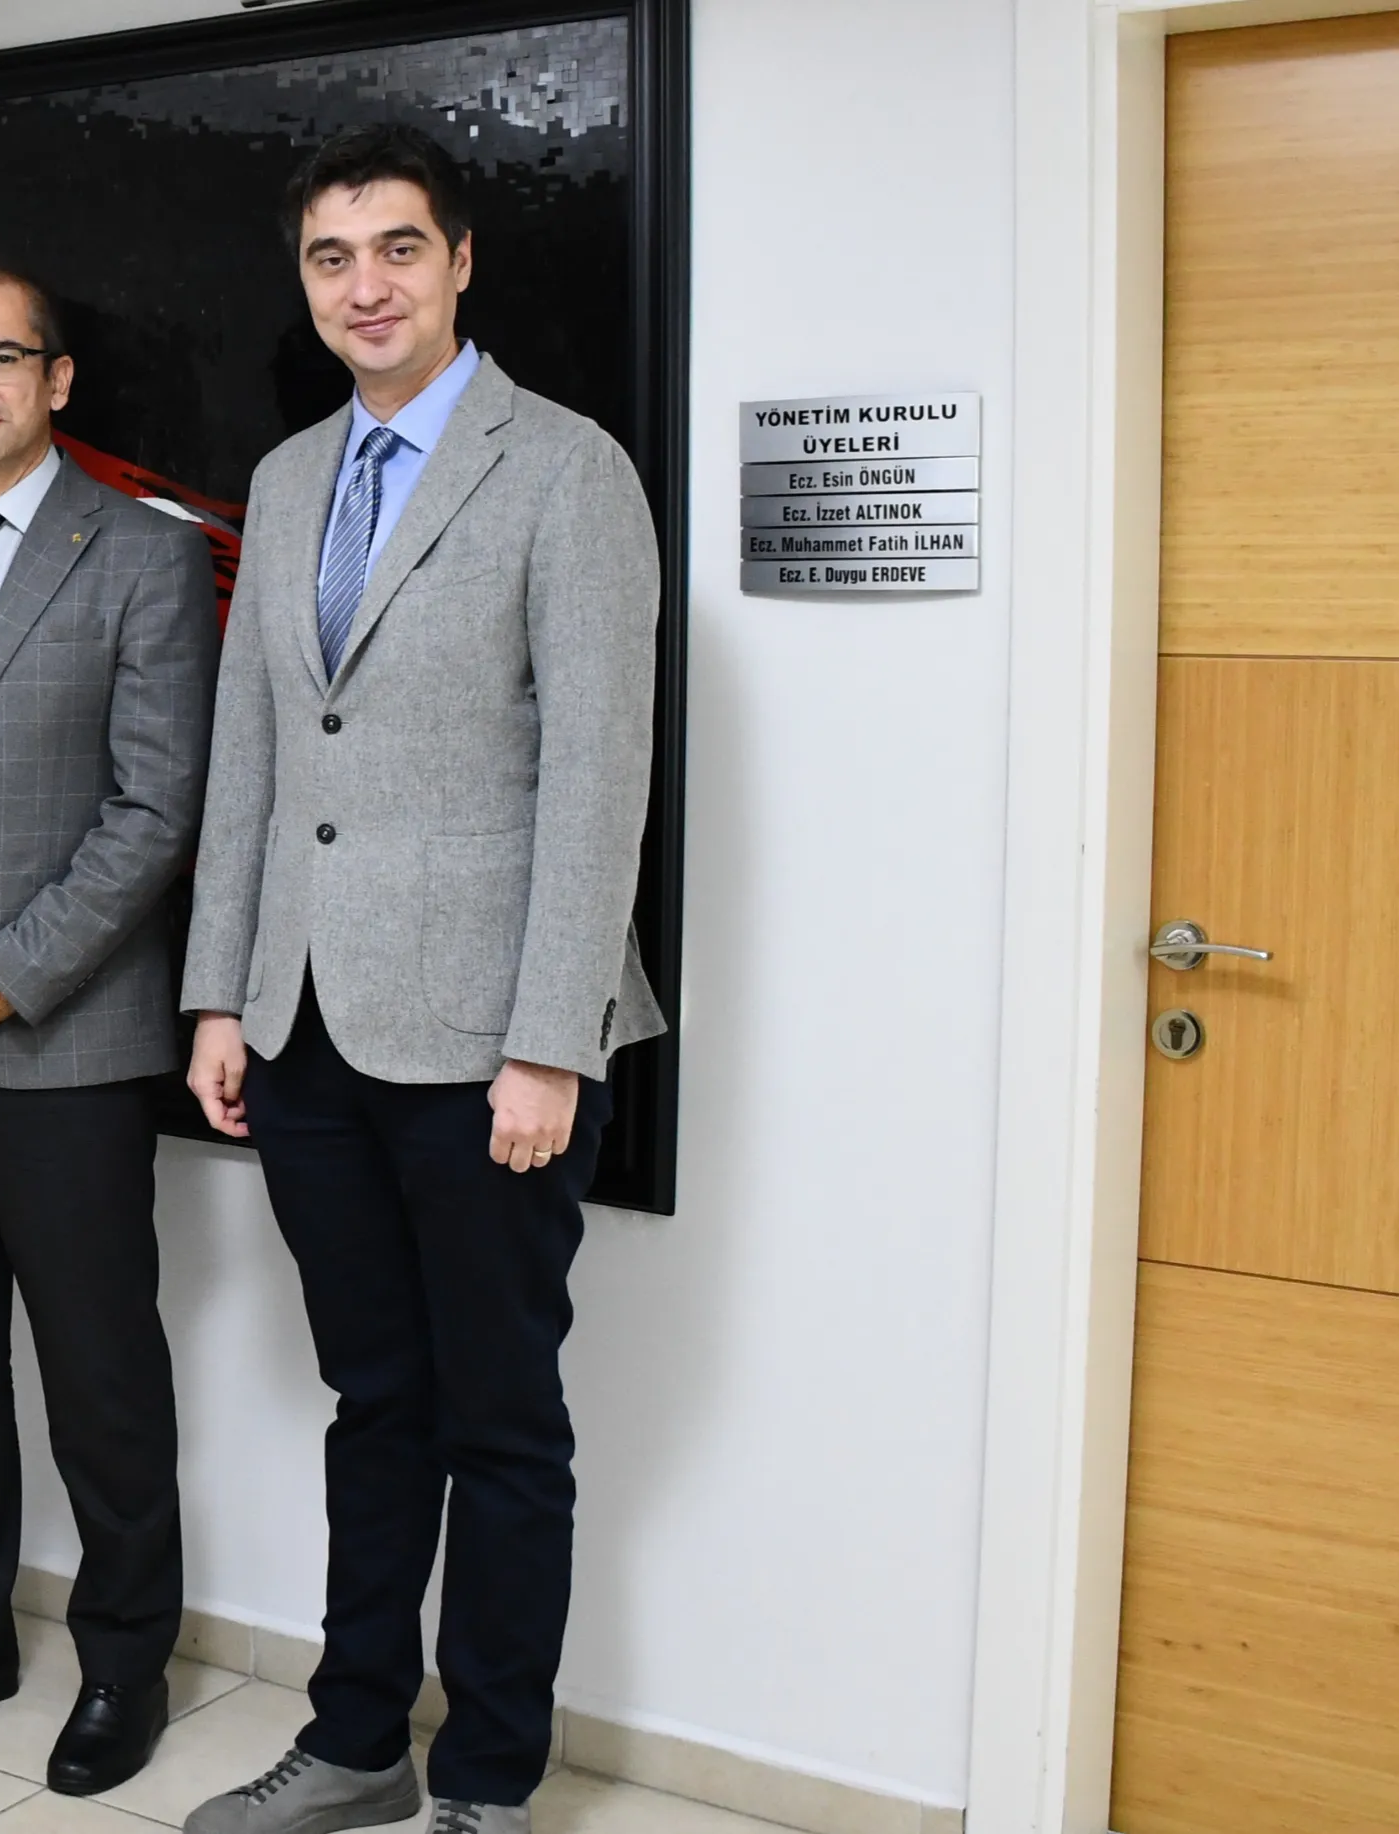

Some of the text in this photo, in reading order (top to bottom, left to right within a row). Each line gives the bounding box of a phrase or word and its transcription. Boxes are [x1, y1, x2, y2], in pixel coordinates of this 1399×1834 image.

[755, 404, 957, 427] YÖNETİM KURULU
[803, 432, 900, 454] ÜYELERİ
[789, 465, 915, 489] Ecz. Esin ÖNGÜN
[783, 502, 922, 521] Ecz. İzzet ALTINOK
[750, 531, 964, 552] Ecz. Muhammet Fatih İLHAN
[780, 567, 926, 583] Ecz. E. Duygu ERDEVE
